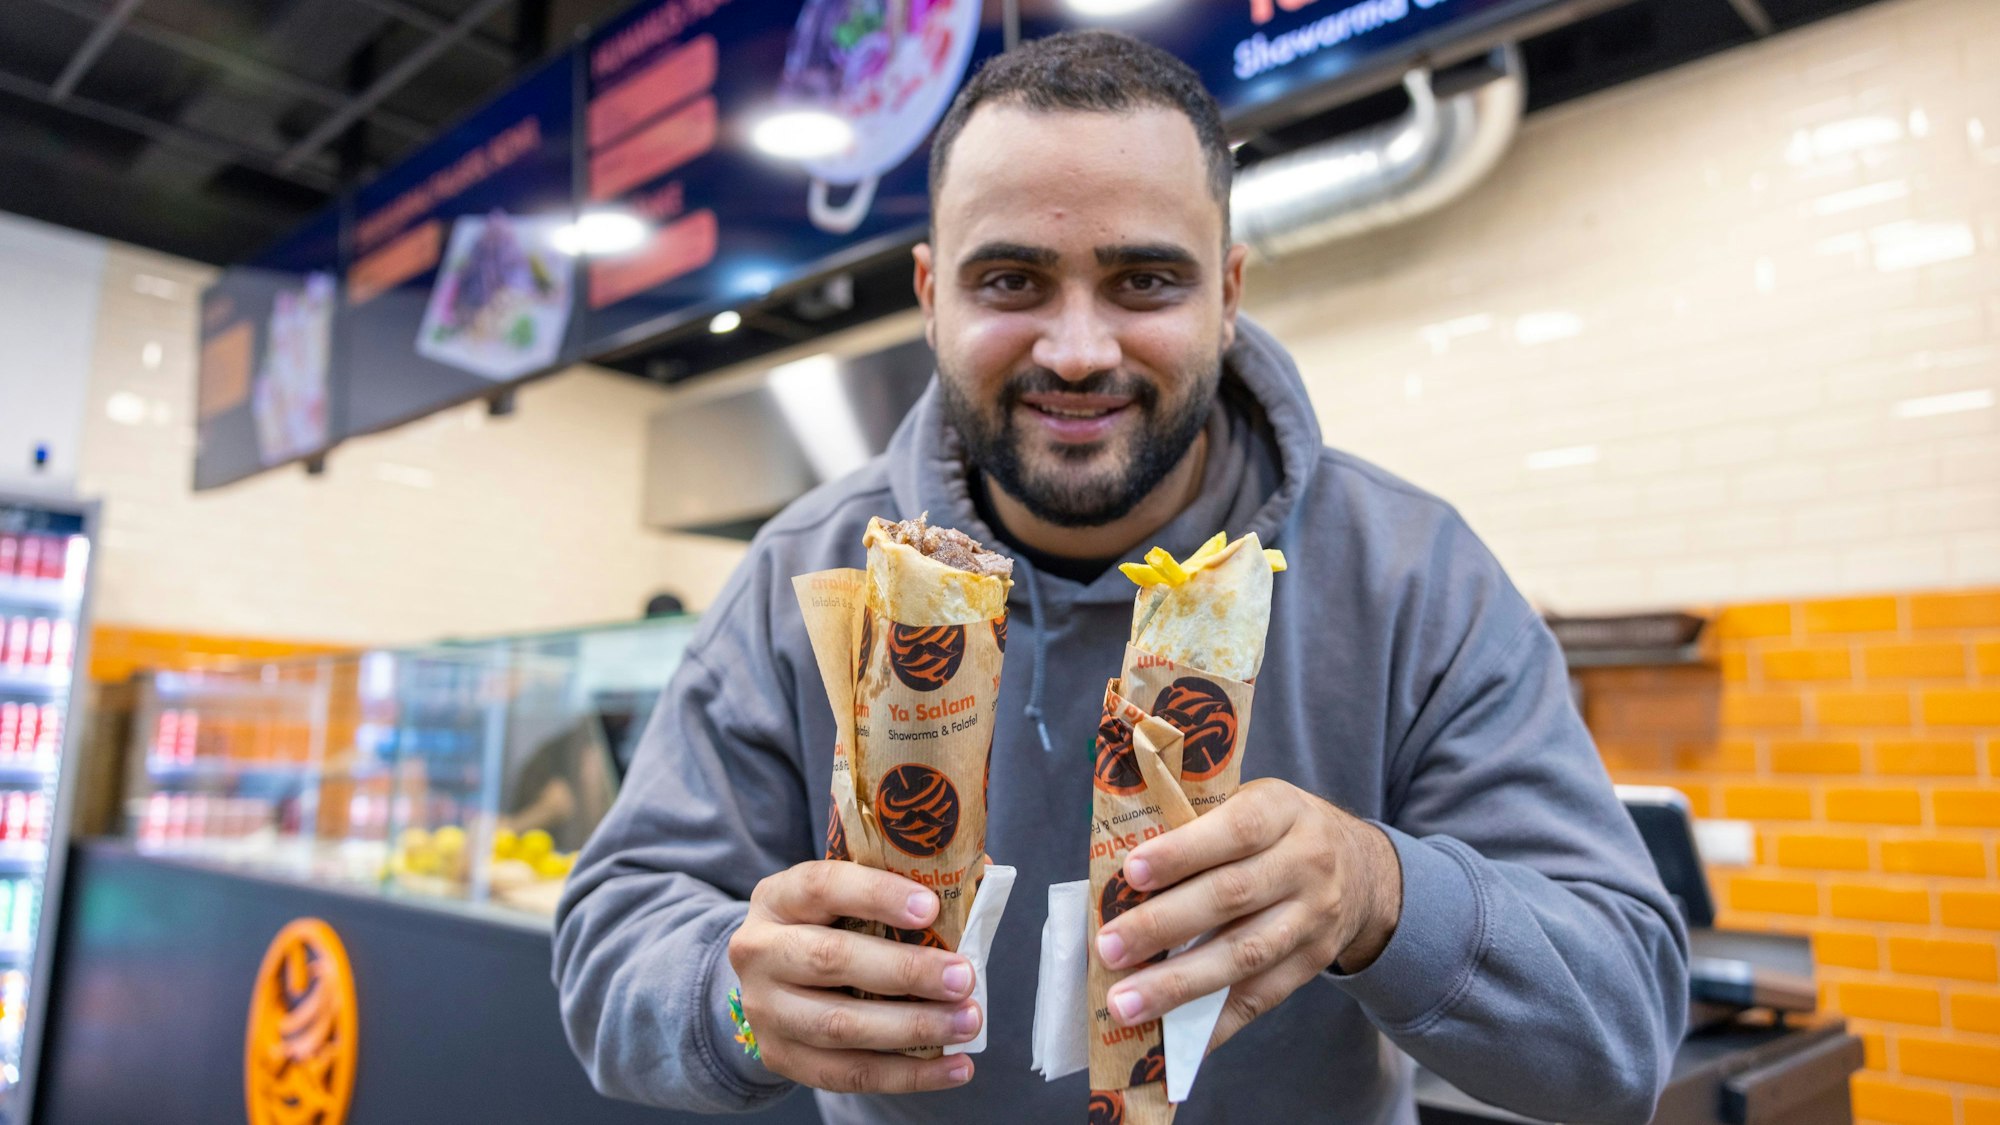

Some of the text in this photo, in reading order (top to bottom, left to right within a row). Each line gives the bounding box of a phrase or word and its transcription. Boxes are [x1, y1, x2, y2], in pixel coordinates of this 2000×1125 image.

[1233, 0, 1410, 80] Shawarma
[1137, 655, 1174, 672] lam
[888, 703, 910, 722] Ya
[915, 694, 976, 722] Salam
[888, 713, 978, 741] Shawarma & Falafel
[1190, 793, 1226, 806] Shawar
[1102, 1019, 1156, 1047] alam
